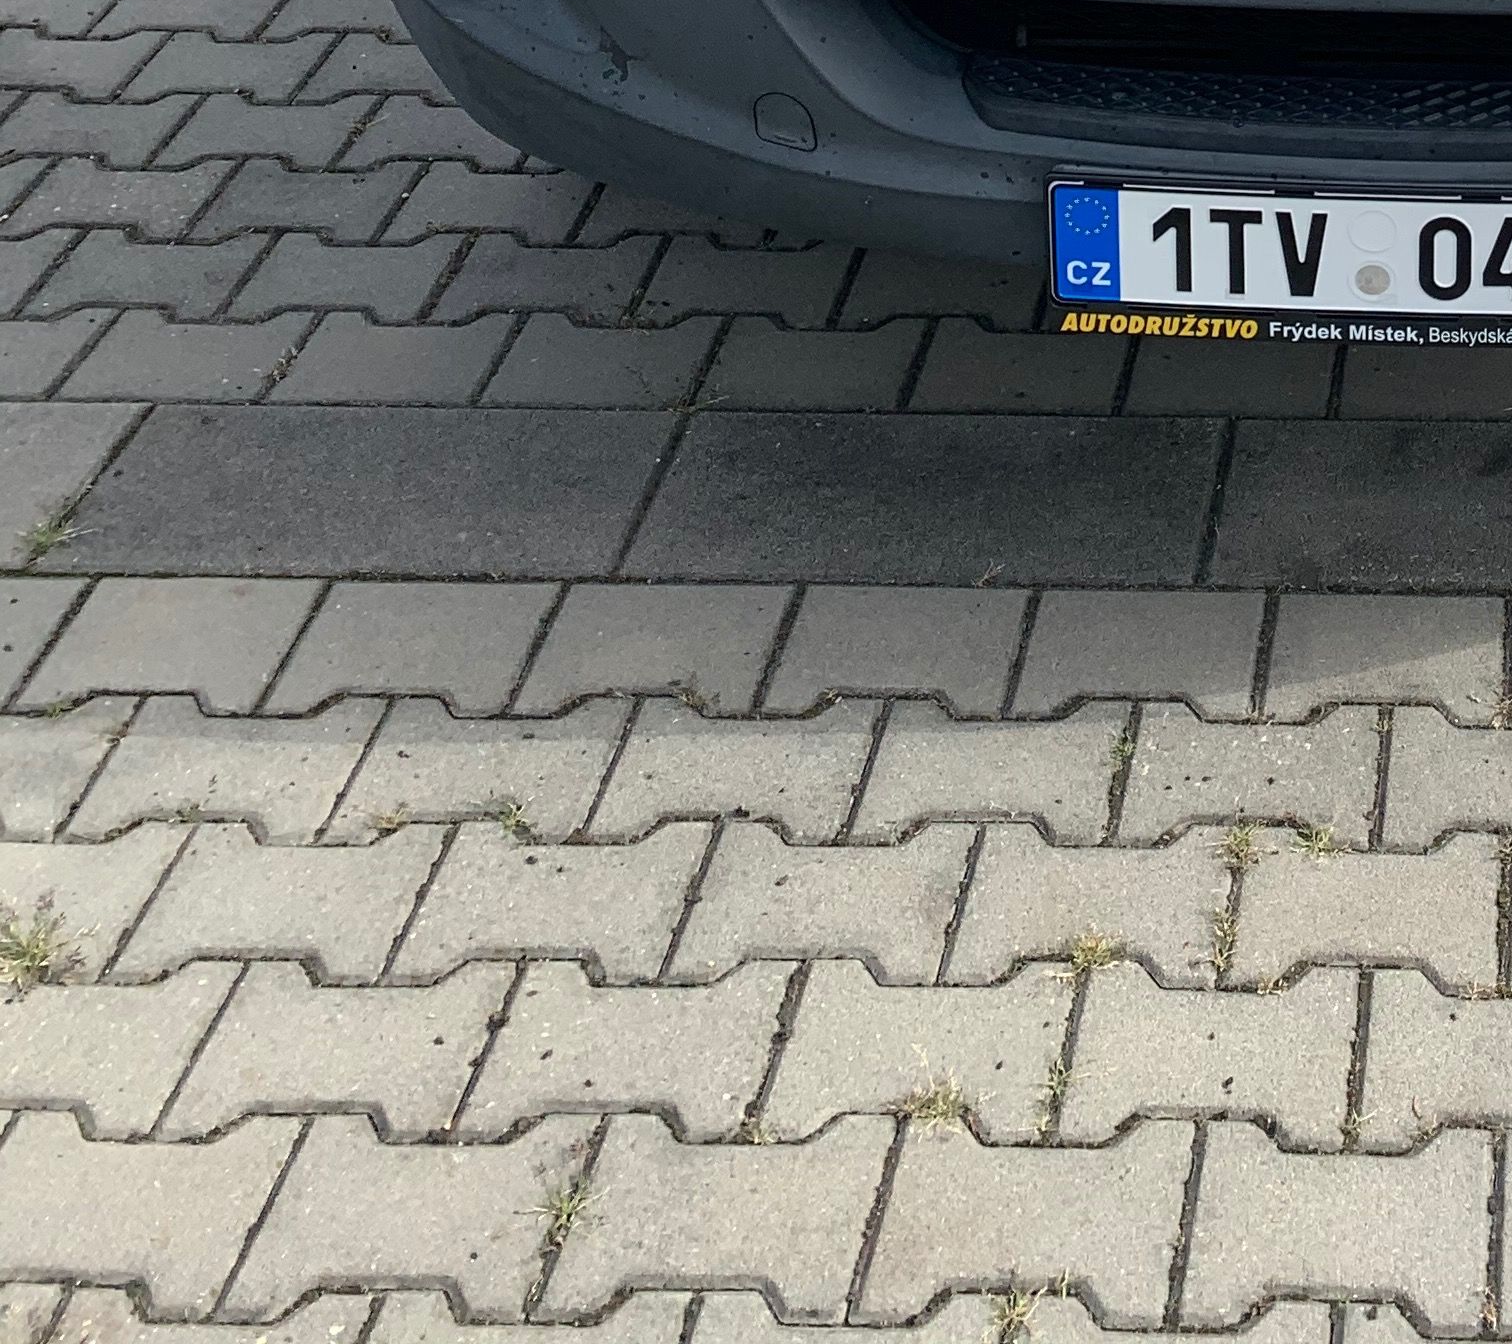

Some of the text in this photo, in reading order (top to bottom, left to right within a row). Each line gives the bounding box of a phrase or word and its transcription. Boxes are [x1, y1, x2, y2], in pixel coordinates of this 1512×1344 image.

[1151, 206, 1330, 298] 1TV
[1065, 260, 1112, 287] CZ
[1060, 313, 1259, 339] AUTODRUŽSTVO
[1269, 321, 1343, 342] Frýdek
[1349, 324, 1424, 345] Místek,
